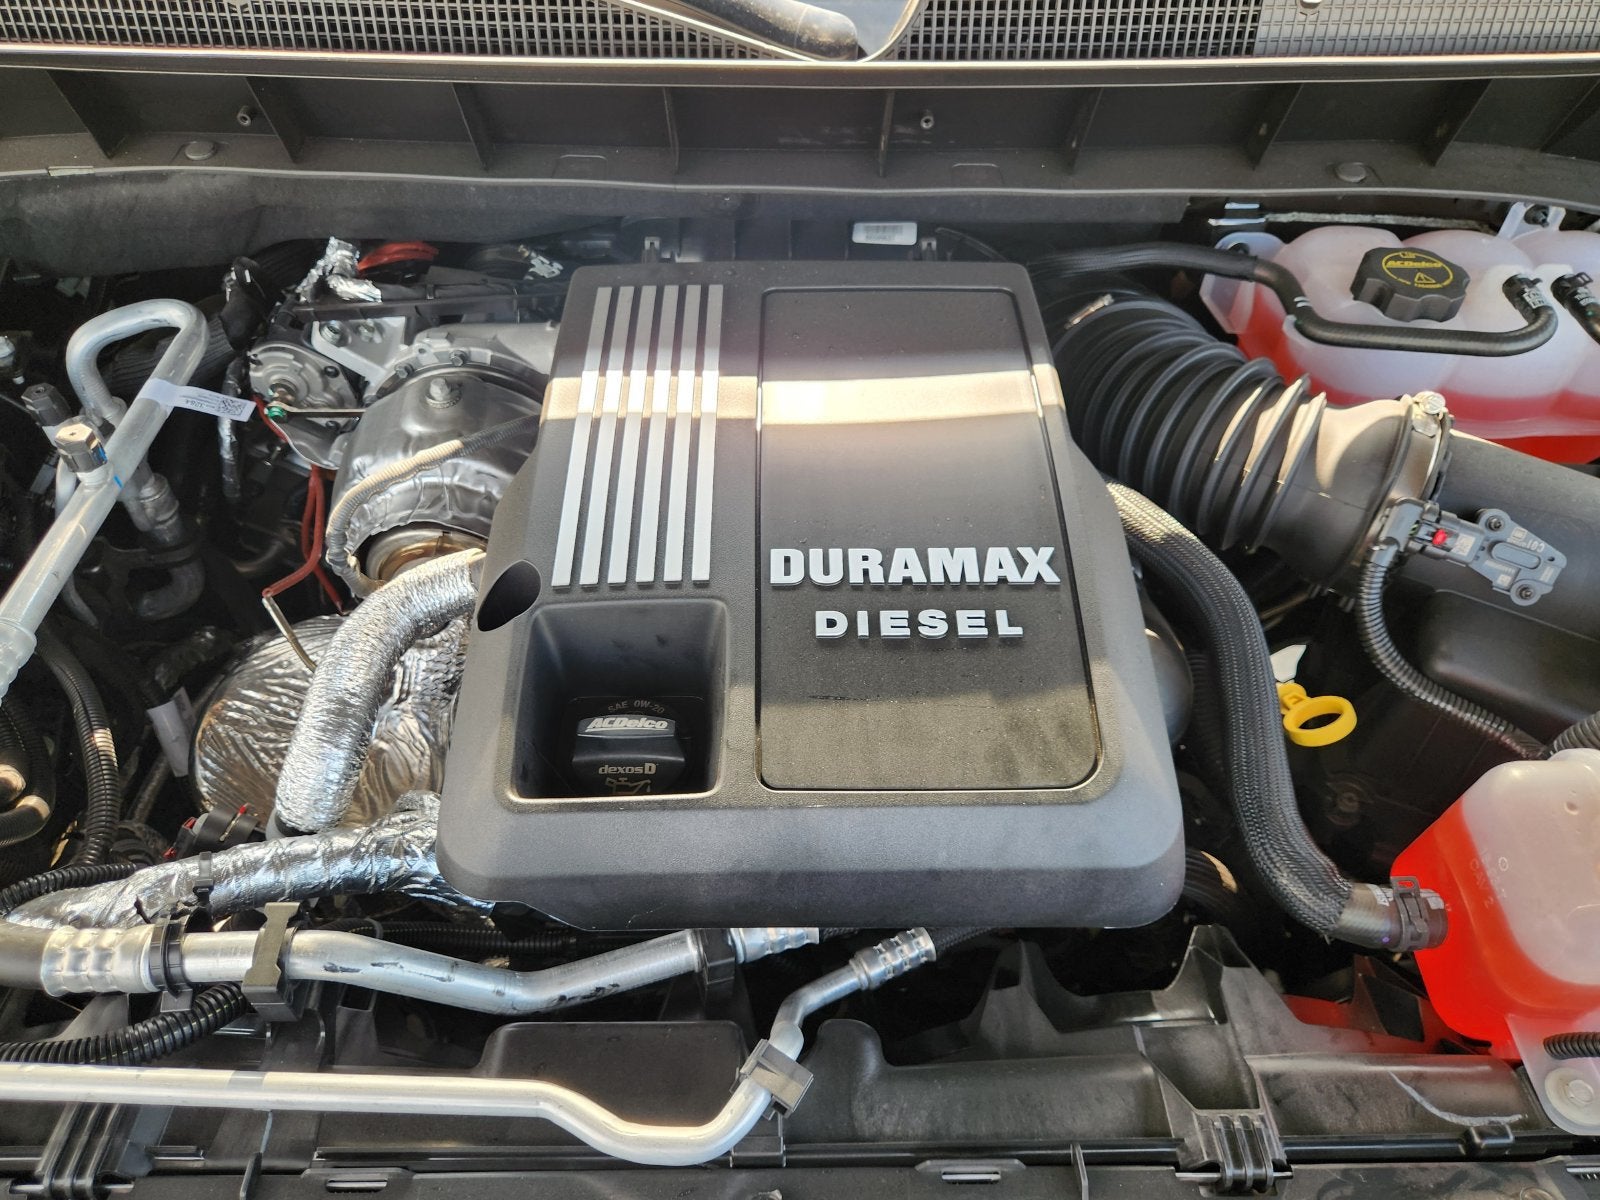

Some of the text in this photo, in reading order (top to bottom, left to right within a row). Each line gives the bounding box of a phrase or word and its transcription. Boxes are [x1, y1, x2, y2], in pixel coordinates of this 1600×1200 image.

[770, 547, 1060, 586] DURAMAX
[815, 609, 1023, 638] DIESEL
[608, 700, 665, 714] SAE 0W-20
[585, 718, 669, 732] ACDelco
[598, 763, 657, 775] dexosD
